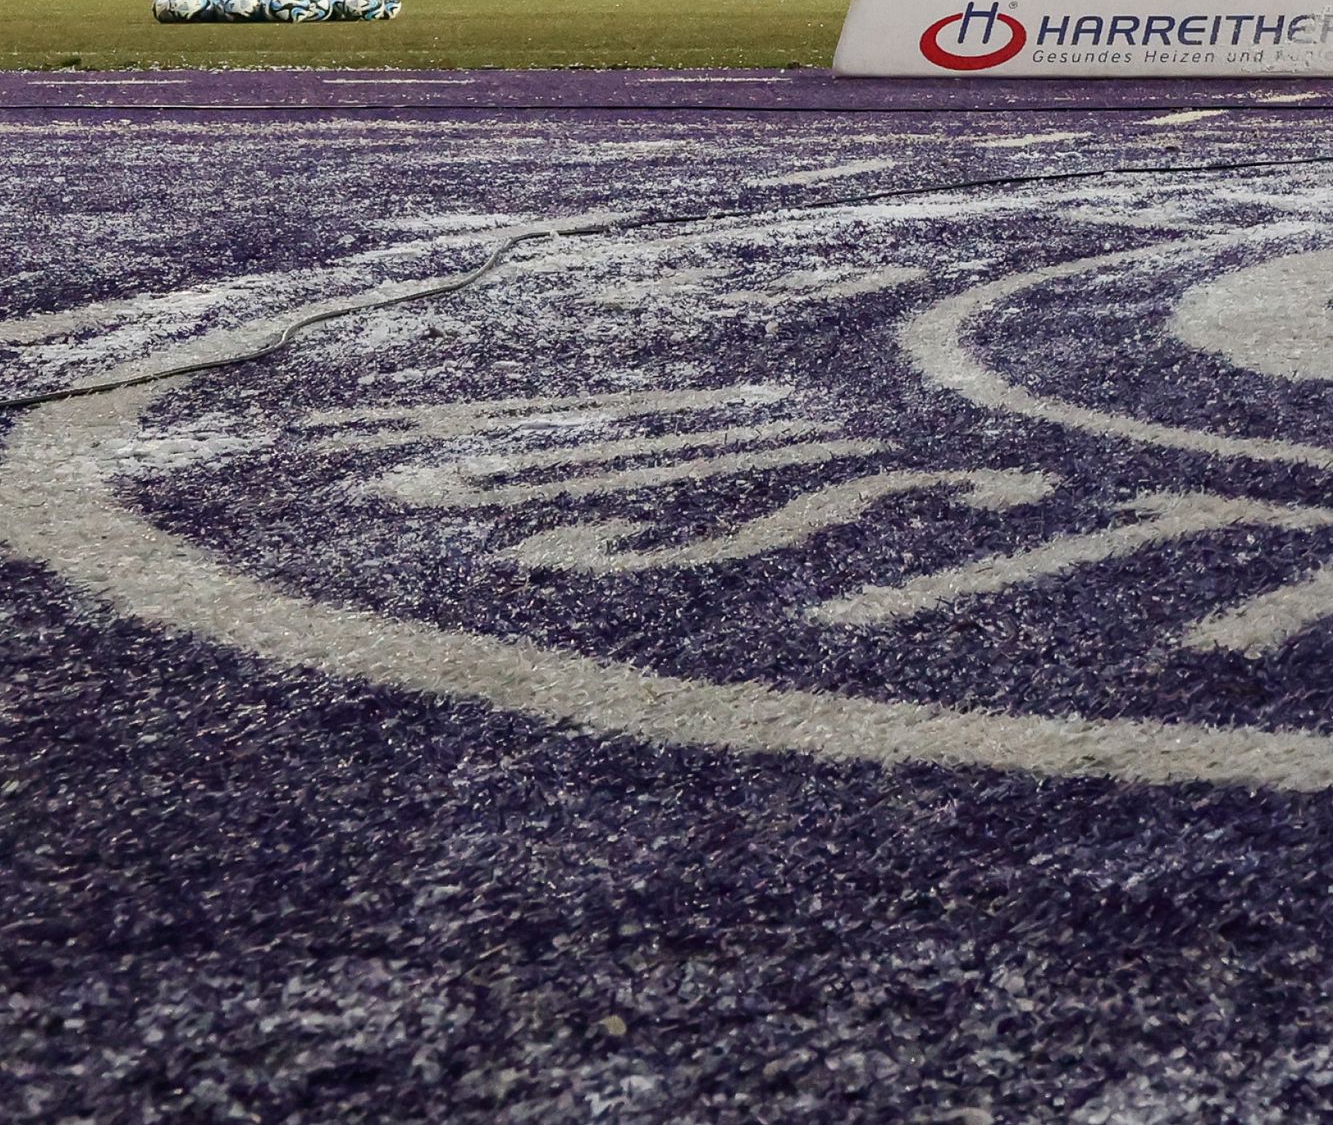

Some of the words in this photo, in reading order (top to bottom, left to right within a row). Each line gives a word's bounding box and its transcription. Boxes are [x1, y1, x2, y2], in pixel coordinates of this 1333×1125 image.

[1032, 49, 1132, 63] Gesundes
[1144, 49, 1215, 63] Heizen
[1227, 49, 1264, 63] und
